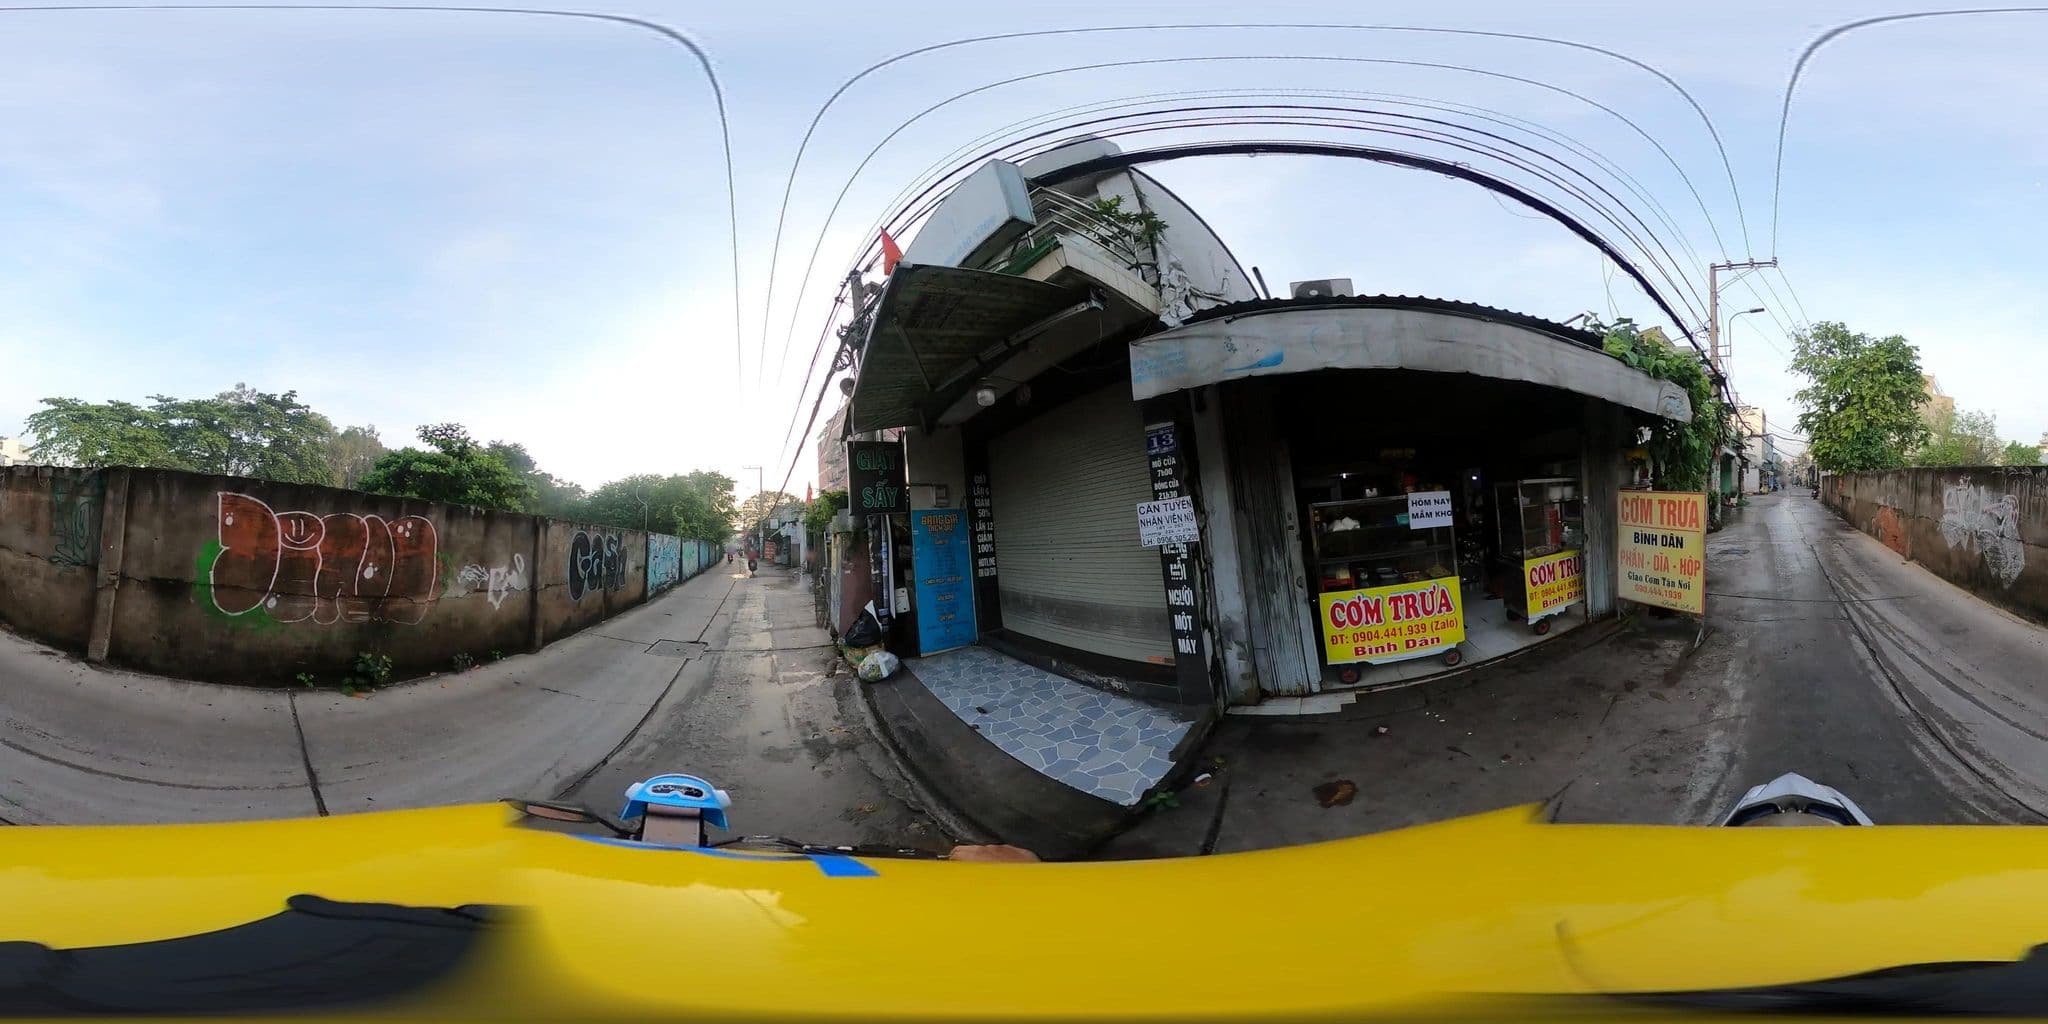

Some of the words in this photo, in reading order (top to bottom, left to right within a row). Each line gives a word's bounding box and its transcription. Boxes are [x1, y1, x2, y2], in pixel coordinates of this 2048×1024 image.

[1150, 433, 1175, 449] 13
[1621, 495, 1653, 525] CƠM
[1658, 497, 1700, 529] TRƯA
[1634, 530, 1658, 546] BÌNH
[1661, 533, 1684, 549] DÂN
[1330, 595, 1384, 629] CƠM
[1388, 584, 1454, 621] TRƯA
[1174, 611, 1193, 633] MỘT
[1331, 633, 1350, 645] ĐT:
[1353, 623, 1427, 643] 0904.441.939
[1430, 617, 1459, 633] (Zalo)
[1178, 635, 1197, 655] MÁY
[1354, 641, 1398, 657] Bình
[1405, 635, 1441, 650] Dân
